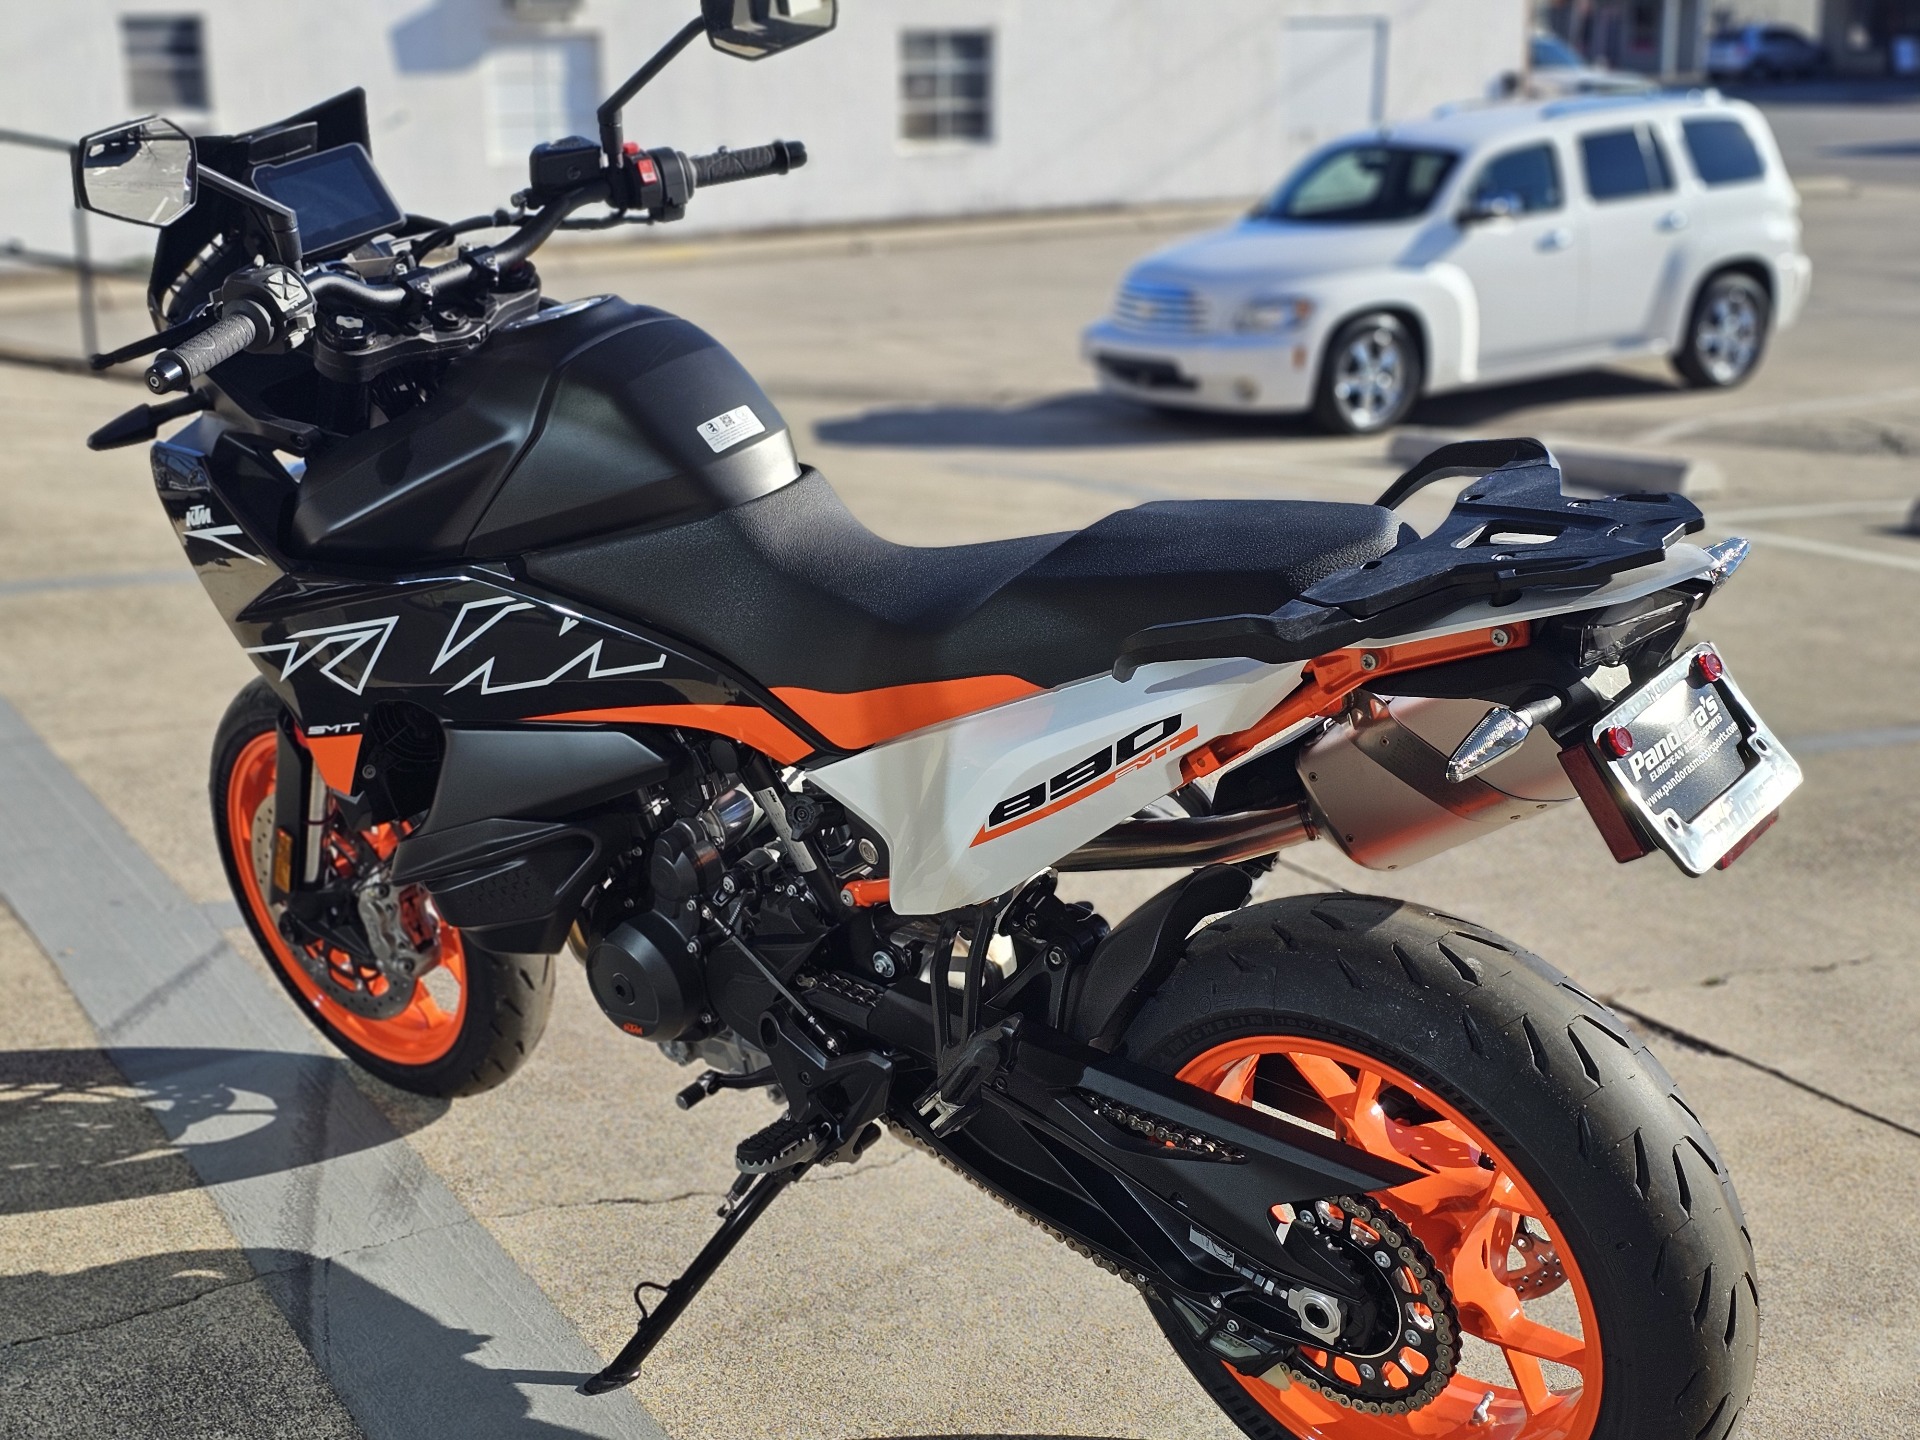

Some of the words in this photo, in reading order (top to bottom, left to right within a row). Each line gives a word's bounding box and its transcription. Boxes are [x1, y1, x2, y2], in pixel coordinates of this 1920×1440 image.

[186, 504, 212, 527] KTM
[308, 722, 360, 735] SMT
[1628, 695, 1719, 781] Pandora's
[989, 713, 1182, 828] 890
[1649, 748, 1685, 782] EUROPEAN
[622, 1022, 644, 1035] KTM
[1168, 1013, 1265, 1056] MICHELIN
